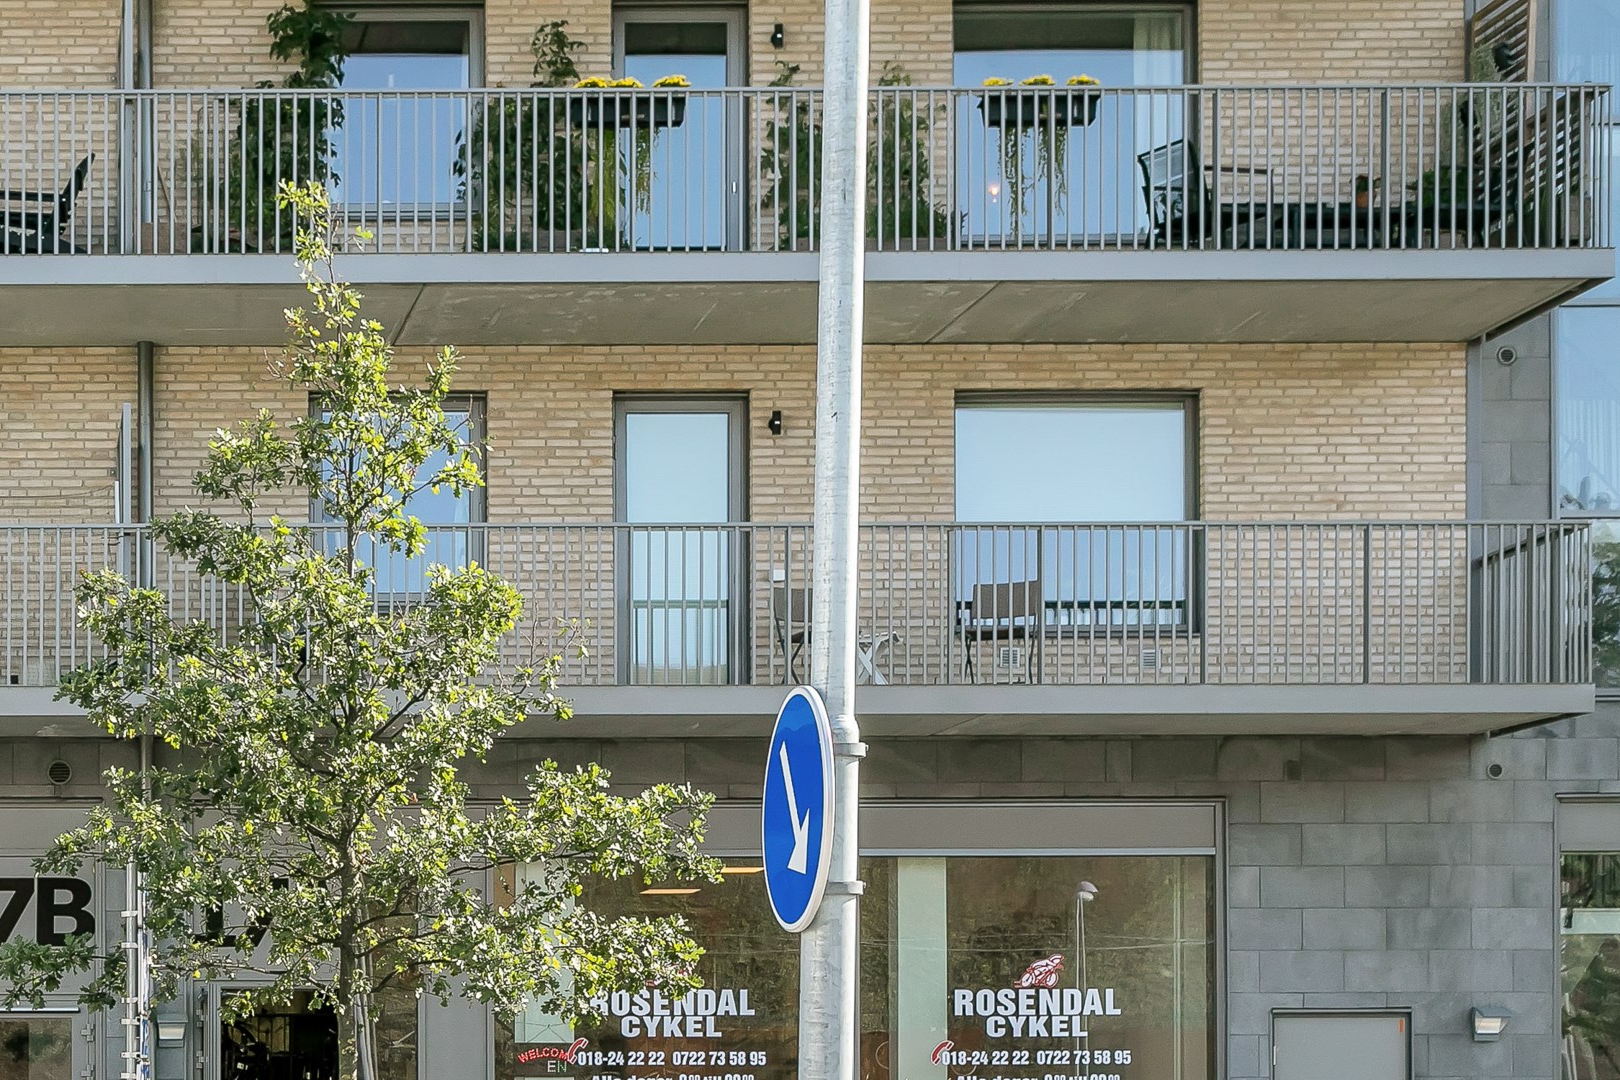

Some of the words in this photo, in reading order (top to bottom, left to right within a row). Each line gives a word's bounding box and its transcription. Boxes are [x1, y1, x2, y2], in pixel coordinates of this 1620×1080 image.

[590, 988, 756, 1017] ROSENDAL
[954, 988, 1122, 1017] ROSENDAL
[620, 1016, 722, 1038] CYKEL
[986, 1015, 1088, 1038] CYKEL
[577, 1051, 624, 1066] 018-24
[629, 1051, 645, 1066] 22
[649, 1051, 665, 1066] 22
[672, 1051, 706, 1066] 0722
[709, 1051, 726, 1066] 73
[729, 1051, 747, 1066] 58
[749, 1051, 767, 1066] 95
[942, 1050, 988, 1065] 018-24
[991, 1050, 1009, 1065] 22
[1012, 1050, 1029, 1065] 22
[1036, 1050, 1070, 1065] 0722
[1073, 1050, 1090, 1065] 73
[1094, 1050, 1111, 1065] 58
[1114, 1050, 1132, 1065] 95
